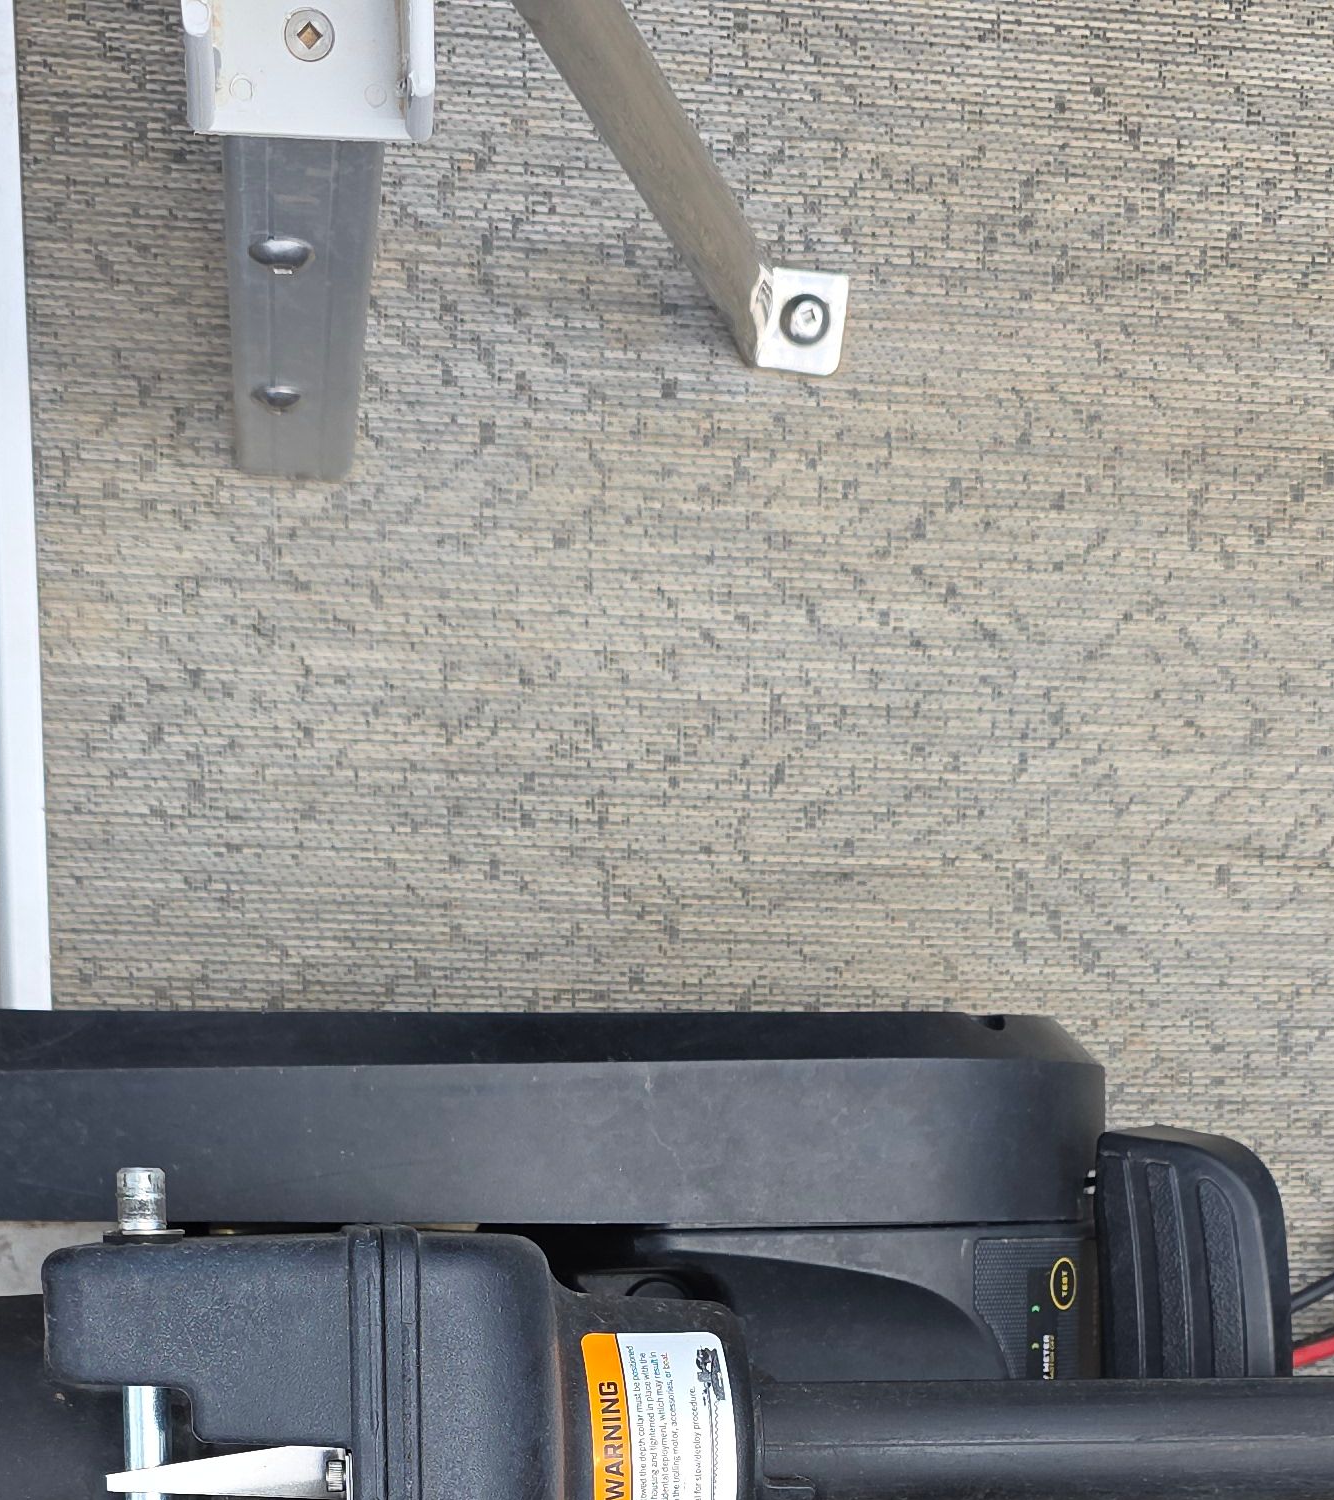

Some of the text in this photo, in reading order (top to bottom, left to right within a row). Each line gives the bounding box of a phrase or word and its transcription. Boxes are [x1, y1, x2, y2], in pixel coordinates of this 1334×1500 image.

[626, 1346, 640, 1380] positioned
[639, 1353, 647, 1363] the
[651, 1359, 660, 1378] result
[641, 1365, 649, 1379] with
[633, 1382, 641, 1391] be
[645, 1382, 654, 1401] place
[655, 1380, 664, 1395] may
[656, 1398, 666, 1420] which
[598, 1382, 624, 1500] WARNING
[647, 1413, 658, 1450] tightened
[638, 1438, 647, 1462] depth
[672, 1456, 681, 1482] trolling
[651, 1470, 659, 1499] housing
